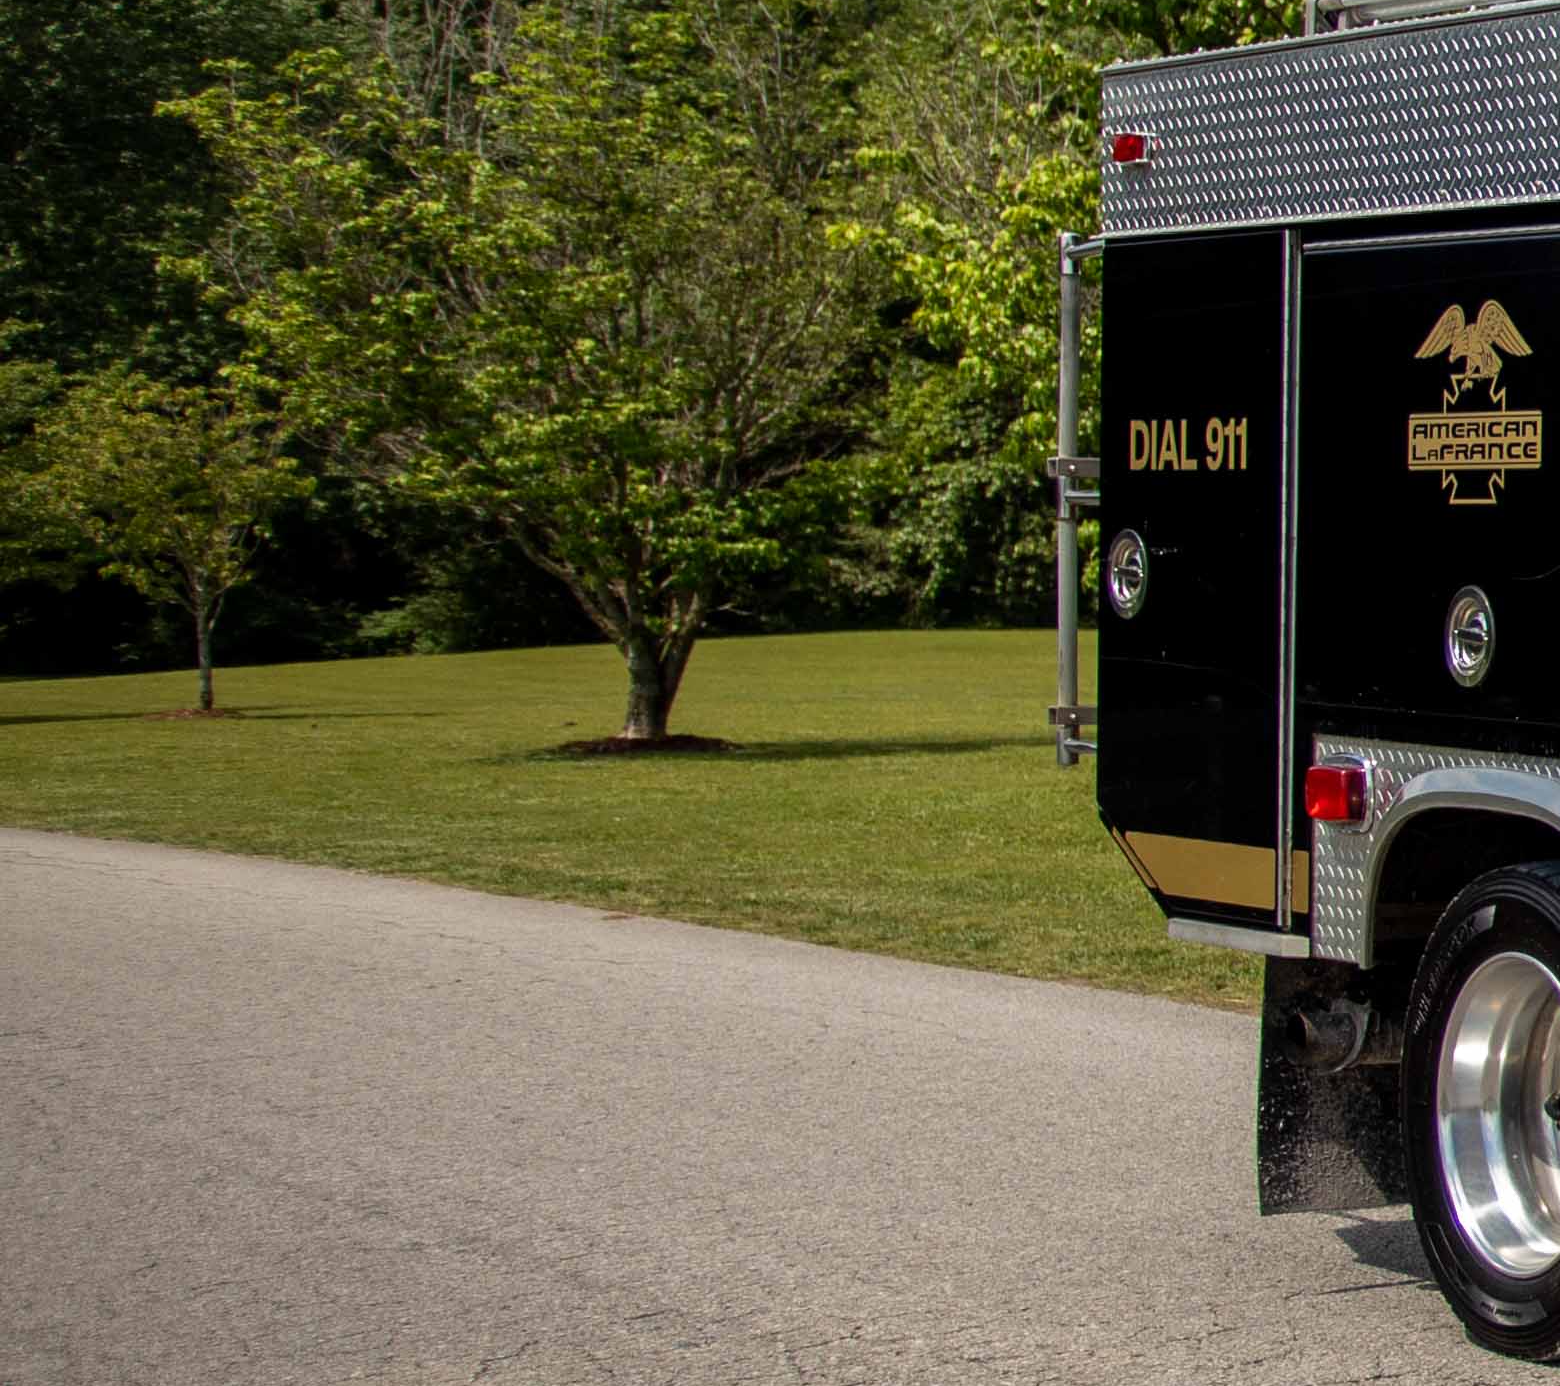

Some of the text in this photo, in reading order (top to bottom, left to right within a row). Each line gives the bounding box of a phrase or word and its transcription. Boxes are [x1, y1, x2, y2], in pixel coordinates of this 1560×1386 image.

[1129, 416, 1248, 471] DIAL 911
[1411, 420, 1538, 440] AMERICAN
